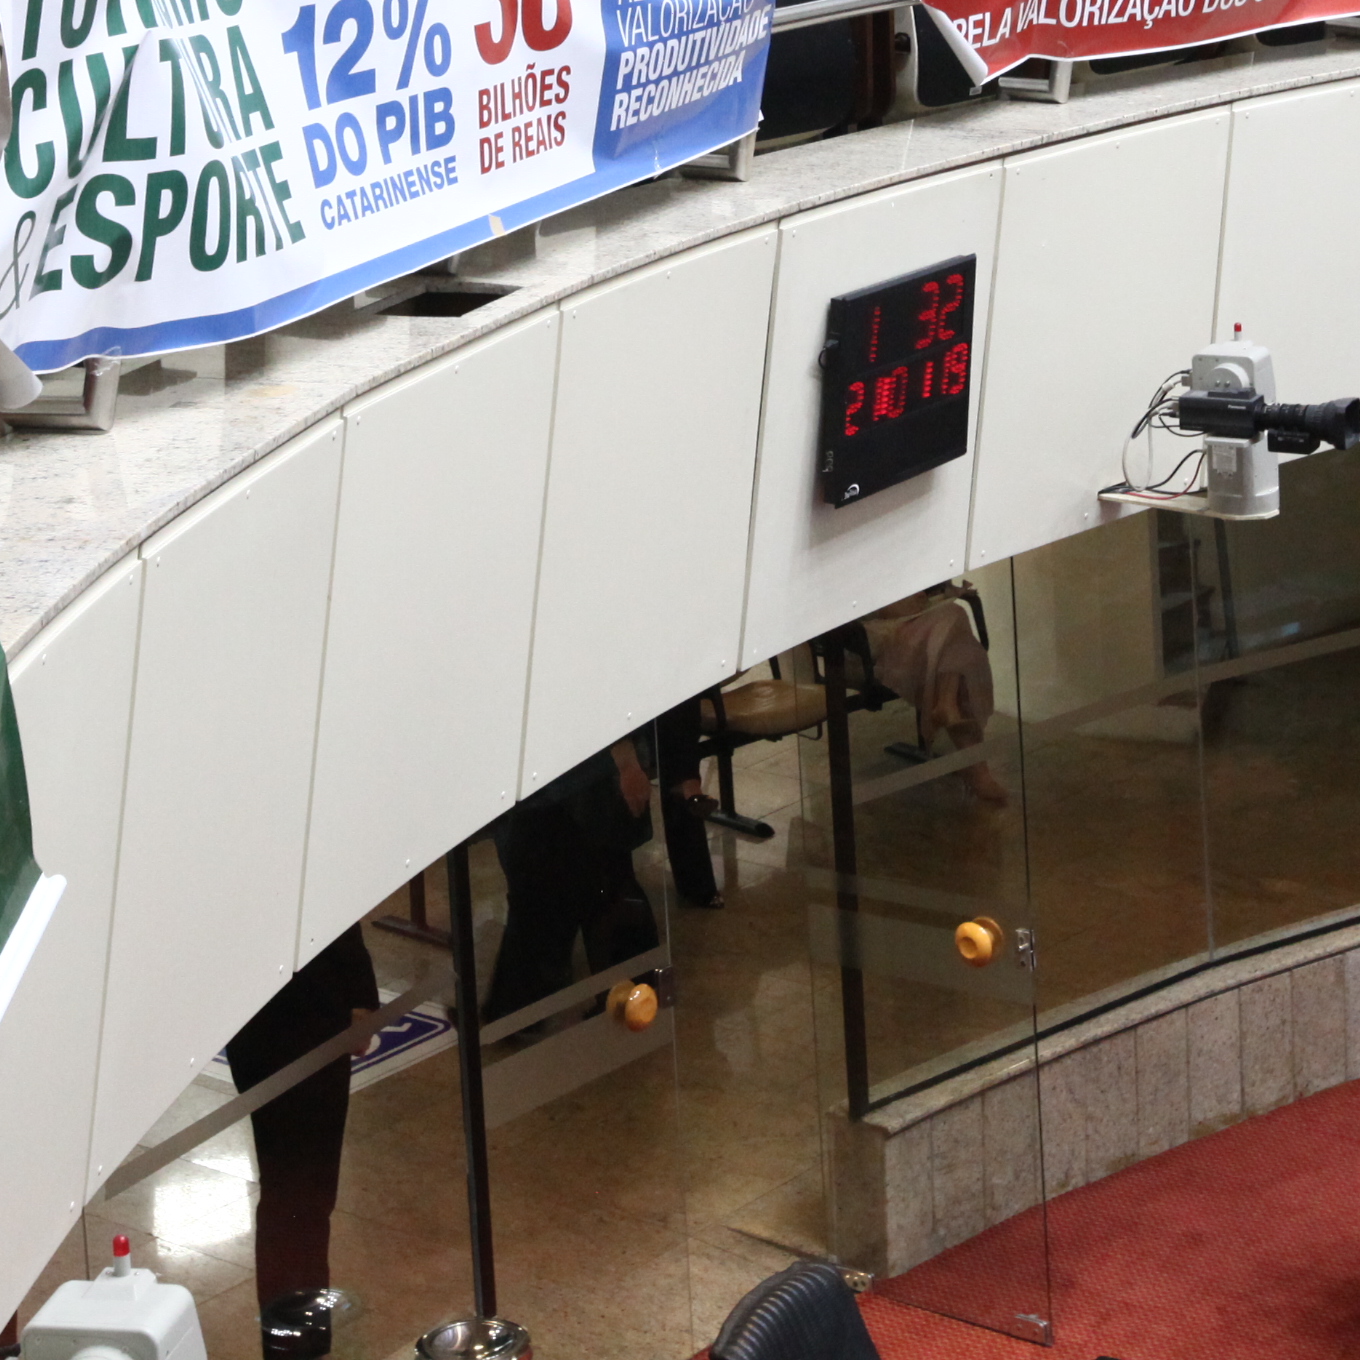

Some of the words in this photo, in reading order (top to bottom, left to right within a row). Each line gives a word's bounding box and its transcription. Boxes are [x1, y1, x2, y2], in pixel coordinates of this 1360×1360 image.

[616, 4, 772, 90] PRODUTIVIDADE
[478, 62, 572, 130] BILHÕES
[610, 50, 746, 132] RECONHECIDA
[302, 112, 367, 189] DO
[375, 86, 456, 166] PIB
[479, 131, 506, 176] DE
[512, 110, 567, 164] REAIS
[29, 140, 307, 302] ESPORTE
[320, 154, 459, 231] CATARINENSE
